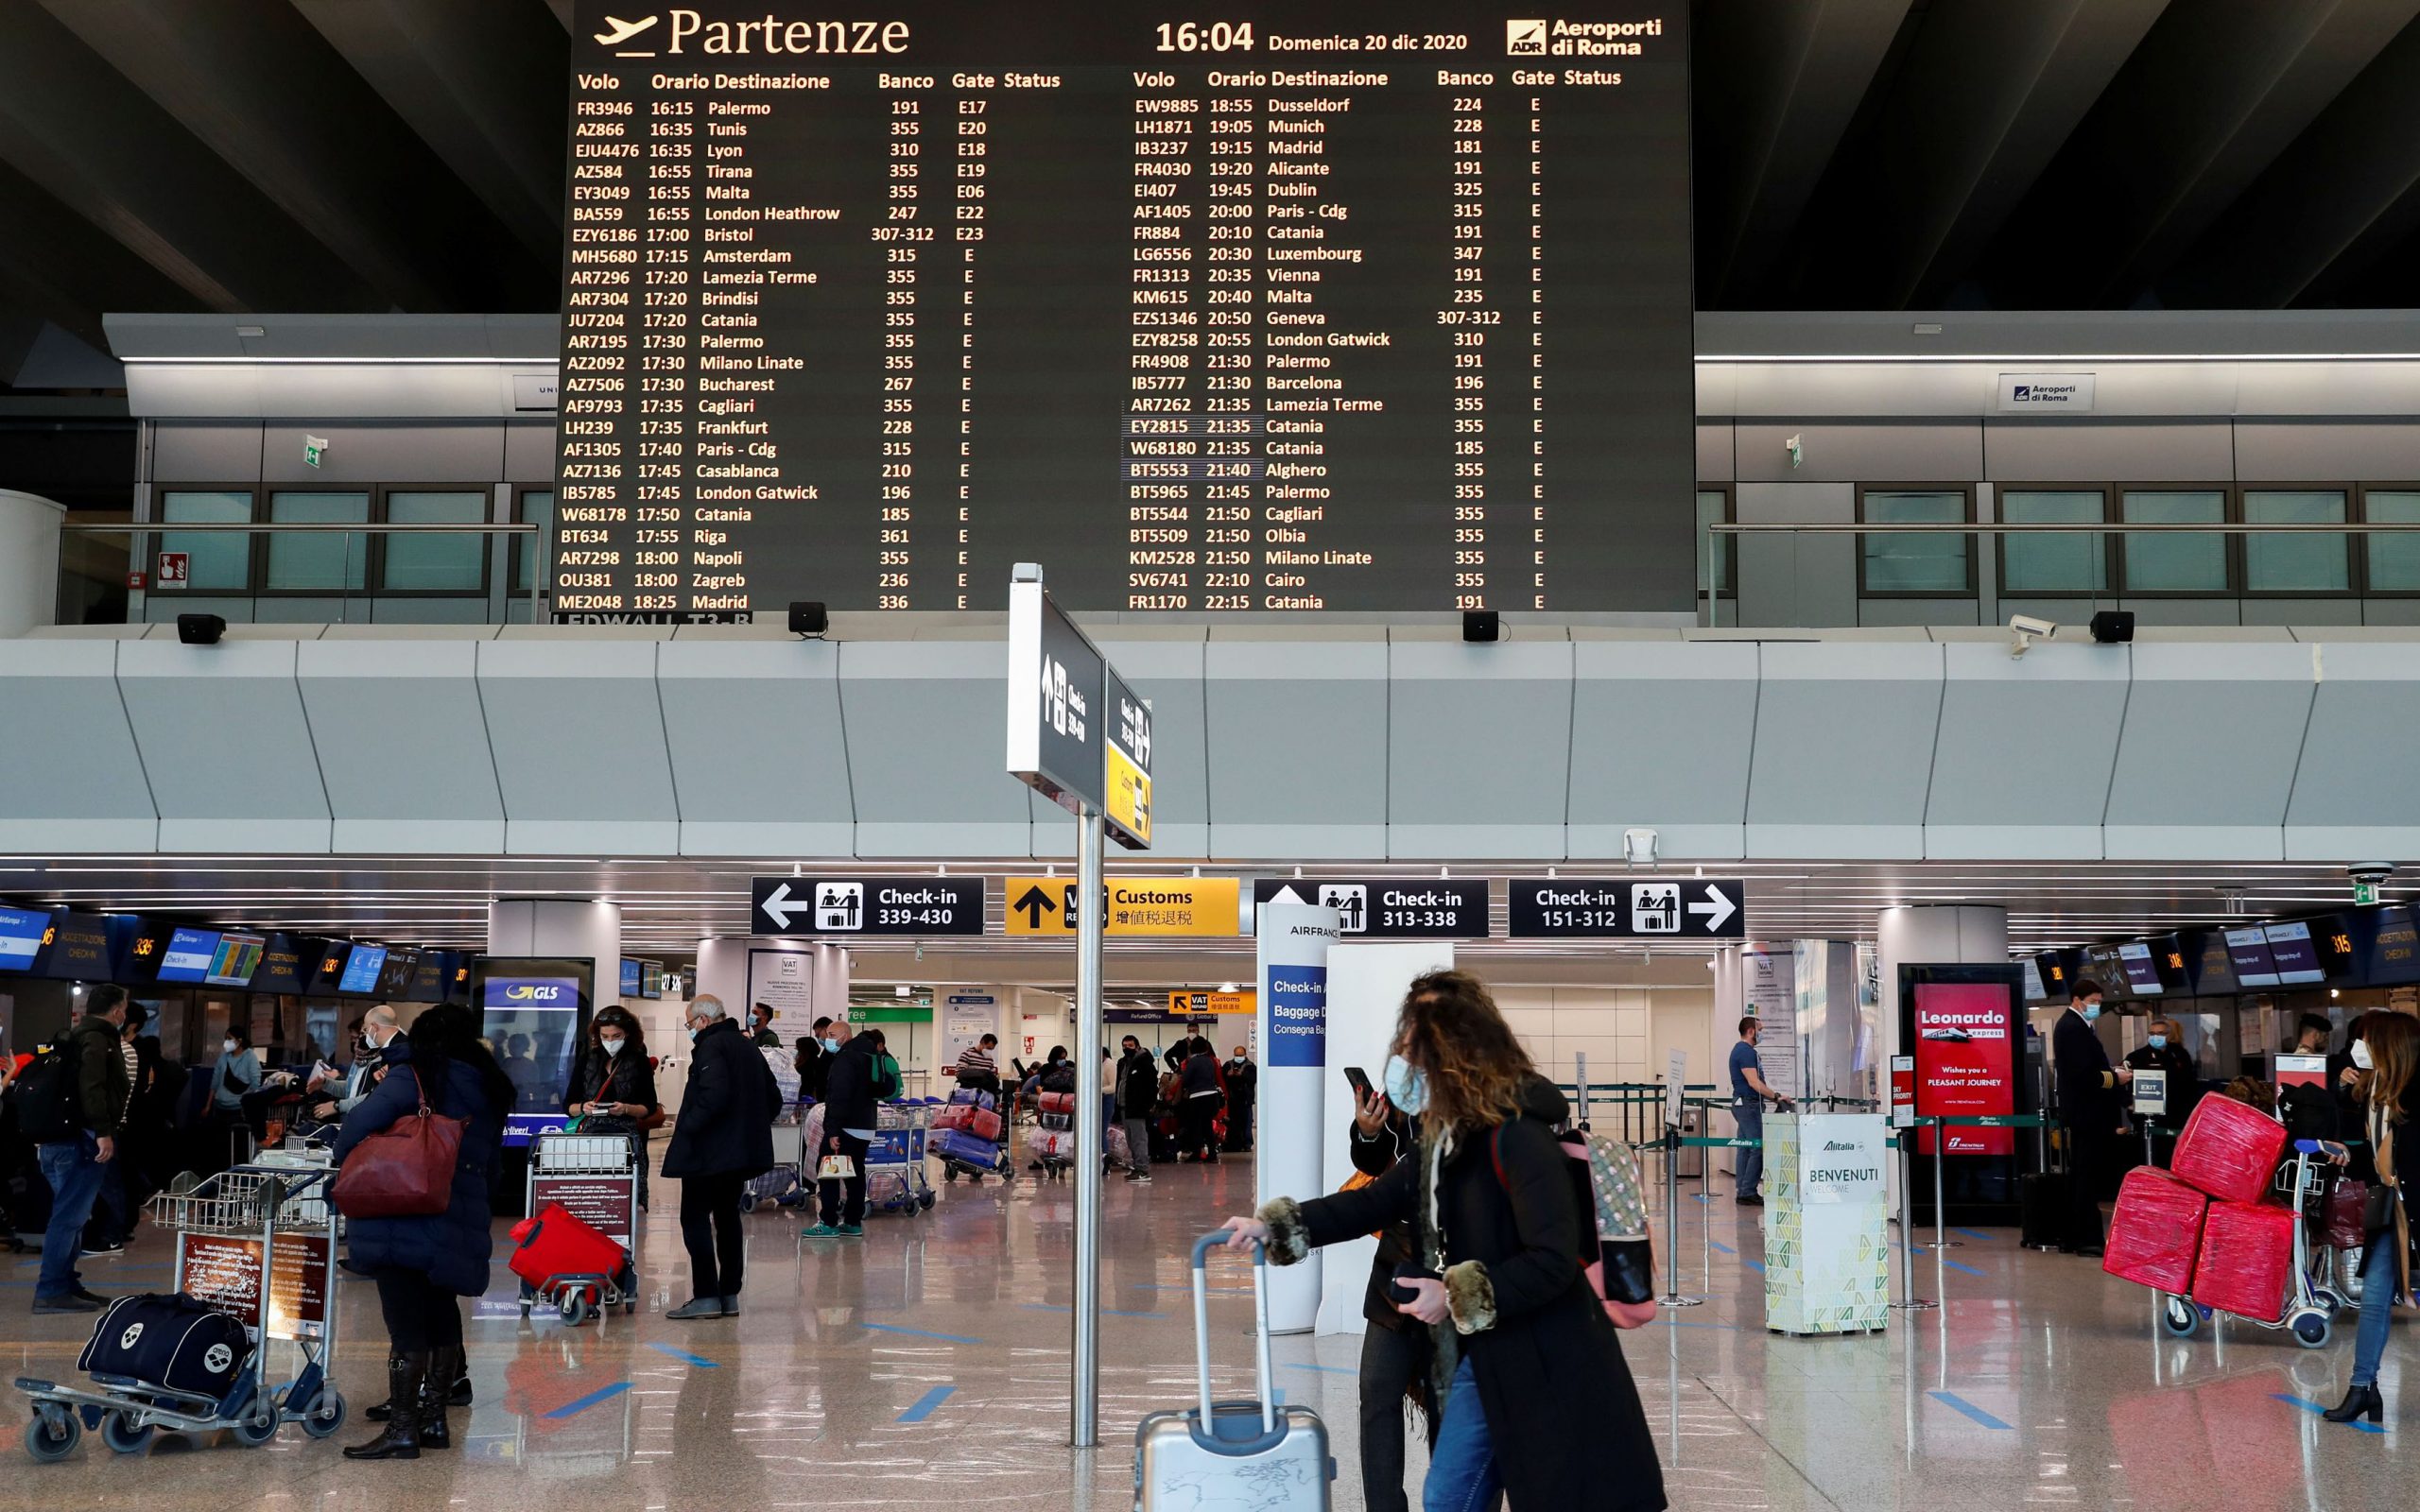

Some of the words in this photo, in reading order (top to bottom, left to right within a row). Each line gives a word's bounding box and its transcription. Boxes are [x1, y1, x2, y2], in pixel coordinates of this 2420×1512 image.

[668, 10, 908, 53] Partenze
[1552, 19, 1661, 40] Aeroporti
[1157, 23, 1253, 51] 16:04
[1269, 34, 1359, 51] Domenica
[1364, 34, 1387, 50] 20
[1392, 34, 1418, 50] dic
[1423, 34, 1467, 50] 2020
[1511, 43, 1544, 54] ADR
[1551, 39, 1573, 56] di
[1577, 39, 1642, 56] Roma
[579, 74, 619, 89] Volo
[652, 74, 709, 89] Orario
[716, 74, 829, 89] Destinazione
[879, 74, 934, 88] Banco
[953, 74, 994, 88] Gate
[1005, 73, 1060, 87] Status
[1133, 72, 1174, 86] Volo
[1208, 71, 1266, 86] Orario
[1272, 71, 1388, 86] Destinazione
[1439, 71, 1493, 85] Banco
[1512, 71, 1554, 84] Gate
[1564, 70, 1621, 84] Status
[578, 102, 632, 114] FR3946
[652, 102, 693, 114] 16:15
[709, 102, 770, 114] Palermo
[892, 102, 919, 113] 191
[959, 101, 986, 113] E17
[1136, 100, 1199, 112] EW9885
[1211, 99, 1252, 112] 18:55
[1270, 98, 1349, 112] Dusseldorf
[1454, 98, 1481, 111] 224
[1532, 98, 1540, 111] E
[1135, 163, 1191, 176] FR4030
[1210, 163, 1253, 175] 19:20
[1268, 162, 1329, 175] Alicante
[1455, 162, 1481, 174] 191
[1532, 162, 1540, 174] E
[575, 187, 630, 199] EY3049
[648, 187, 690, 198] 16:55
[706, 186, 749, 198] Malta
[890, 185, 917, 198] 355
[958, 185, 984, 198] E06
[574, 229, 636, 241] EZY6186
[648, 229, 689, 241] 17:00
[705, 228, 752, 241] Bristol
[872, 228, 933, 240] 307-312
[957, 228, 983, 240] E23
[1134, 269, 1189, 282] FR1313
[1209, 269, 1251, 282] 20:35
[1267, 268, 1320, 281] Vienna
[1455, 268, 1482, 281] 191
[1533, 268, 1541, 281] E
[1132, 377, 1185, 389] IB5777
[1207, 377, 1251, 389] 21:30
[1267, 376, 1341, 389] Barcelona
[1456, 376, 1483, 388] 196
[1534, 376, 1542, 388] E
[2032, 386, 2076, 394] Aeroporti
[1132, 464, 1188, 476] BT5553
[1207, 464, 1251, 476] 21:40
[1266, 463, 1326, 479] Alghero
[1455, 463, 1483, 475] 355
[1534, 463, 1543, 476] E
[563, 487, 615, 499] IB5785
[638, 487, 680, 499] 17:45
[696, 486, 752, 500] London
[755, 486, 818, 500] Gatwick
[883, 487, 910, 499] 196
[960, 486, 968, 498] E
[560, 595, 621, 609] ME2048
[634, 595, 676, 609] 18:25
[693, 595, 747, 609] Madrid
[879, 595, 908, 610] 336
[958, 596, 967, 610] E
[1129, 595, 1187, 610] FR1170
[1205, 595, 1250, 610] 22:15
[1265, 594, 1323, 610] Catania
[1456, 595, 1484, 609] 191
[1535, 595, 1544, 609] E
[879, 888, 958, 904] Check-in
[1115, 889, 1192, 904] Customs
[1383, 890, 1462, 906] Check-in
[1536, 889, 1616, 905] Check-in
[879, 909, 953, 924] 339-430
[1383, 911, 1457, 926] 313-338
[1543, 911, 1616, 926] 151-312
[1290, 925, 1340, 939] AIRFRANCE
[133, 937, 155, 955] 335
[2331, 934, 2352, 954] 315
[2168, 953, 2183, 969] 318
[533, 987, 559, 1000] GLS
[1273, 981, 1322, 993] Check-in
[1191, 996, 1207, 1005] VAT
[1273, 1005, 1320, 1020] Baggage
[1921, 1010, 2005, 1024] Leonardo
[1273, 1024, 1315, 1036] Consegna
[1972, 1029, 2003, 1038] express
[1727, 1138, 1754, 1146] Alitalia
[1823, 1141, 1855, 1151] Alitalia
[1810, 1168, 1879, 1182] BENVENUTI
[1810, 1184, 1850, 1194] WELCOME
[212, 1347, 230, 1357] arena
